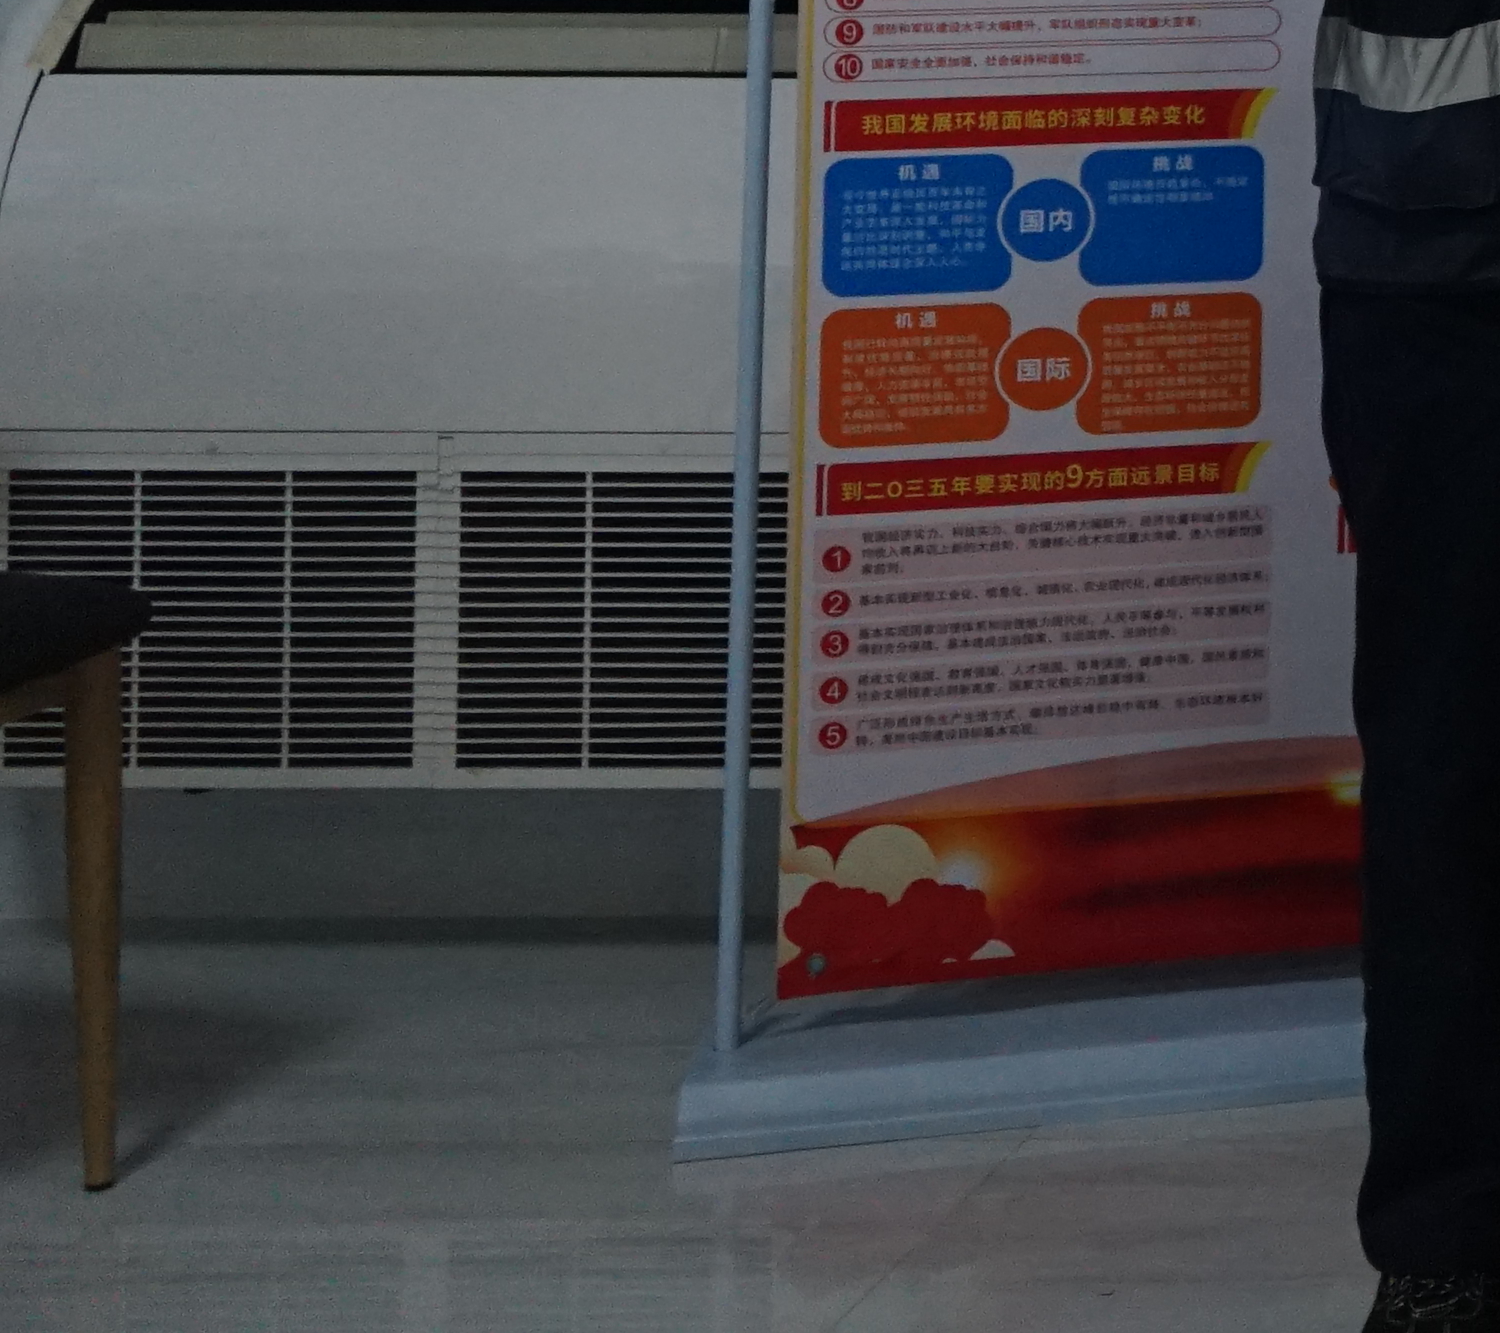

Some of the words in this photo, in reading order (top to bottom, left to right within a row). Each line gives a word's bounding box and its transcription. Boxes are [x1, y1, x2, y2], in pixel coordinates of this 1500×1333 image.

[861, 104, 1206, 135] 我国发展环境面临的深刻复杂变化
[1019, 209, 1074, 234] 国内
[1016, 357, 1071, 383] 国际
